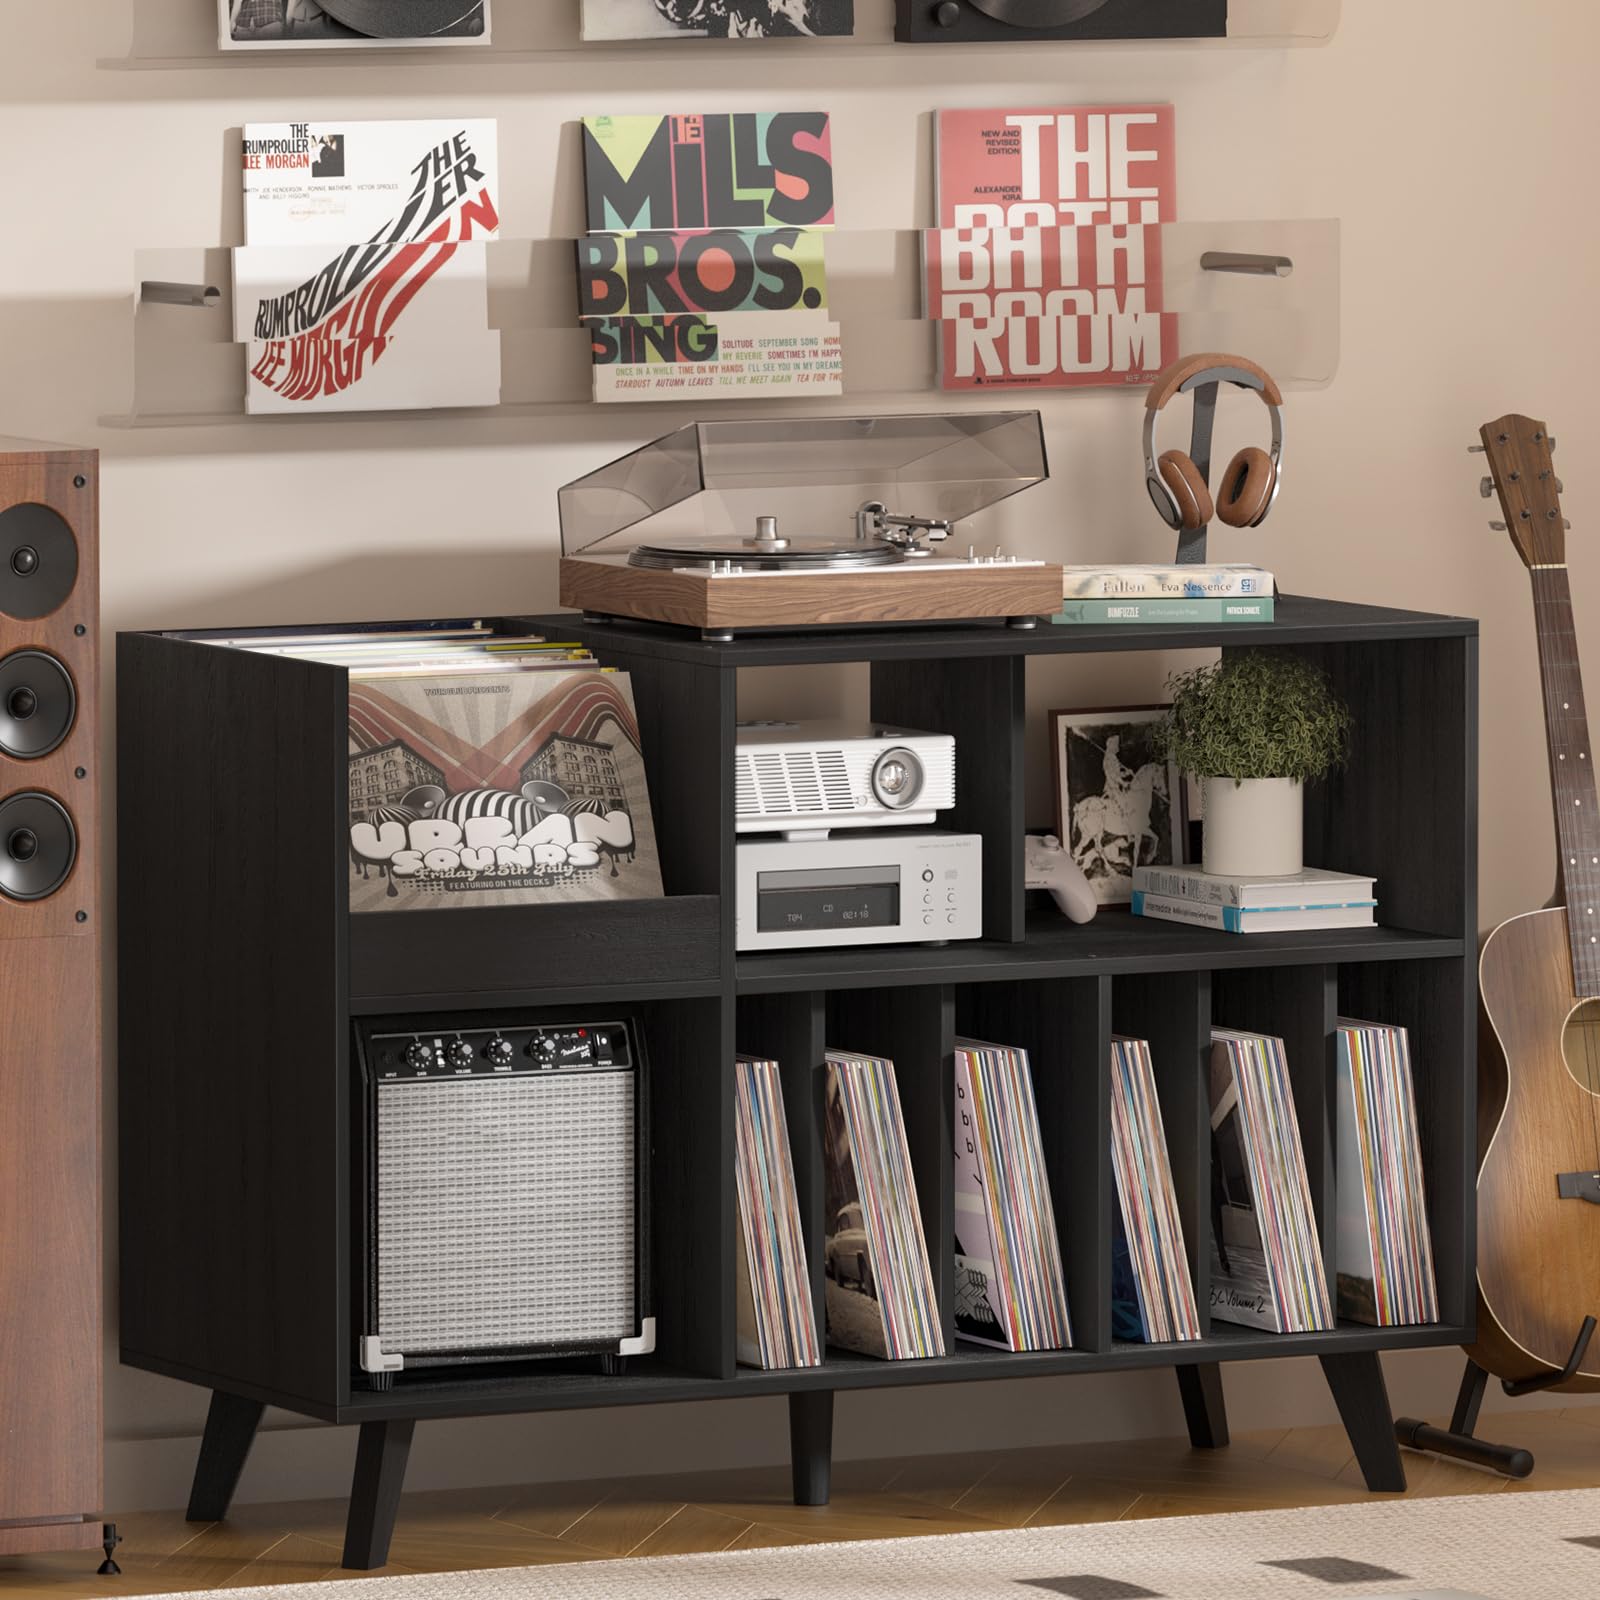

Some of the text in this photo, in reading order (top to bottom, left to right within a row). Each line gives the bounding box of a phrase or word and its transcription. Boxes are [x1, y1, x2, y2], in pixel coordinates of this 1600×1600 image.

[290, 123, 309, 138] THE
[243, 139, 310, 154] RUMPROLLER
[987, 147, 1020, 155] EDITION
[242, 154, 310, 169] LEE MORGAN
[1005, 113, 1158, 200] THE
[406, 130, 472, 201] THE
[940, 200, 1159, 291] BATH
[576, 231, 822, 316] BROS.
[585, 314, 718, 364] SING
[942, 287, 1161, 377] ROOM
[722, 339, 753, 348] SOLITUDE
[758, 338, 797, 347] SEPTEMBER
[800, 337, 819, 346] SONG
[723, 349, 842, 360] MY REVERIE SOMETIMES I'M HAPPY
[250, 340, 286, 389] LEE
[615, 367, 633, 376] ONCE
[636, 367, 643, 376] IN
[646, 367, 650, 375] A
[653, 366, 673, 375] WHILE
[678, 366, 694, 375] TIME
[697, 365, 706, 374] ON
[708, 365, 719, 373] MY
[721, 364, 744, 373] HANDS
[763, 363, 775, 372] SEE
[778, 363, 791, 371] YOU
[793, 362, 801, 370] IN
[803, 361, 813, 370] MY
[816, 361, 842, 370] DREAMS
[615, 379, 651, 389] STARDUST
[656, 378, 685, 387] AUTUMN
[688, 377, 714, 387] LEAVES
[719, 376, 733, 385] TILL
[736, 376, 746, 385] WE
[750, 375, 768, 384] MEET
[771, 374, 793, 384] AGAIN
[797, 374, 810, 383] TEA
[813, 373, 826, 382] FOR
[1161, 583, 1232, 592] Eva Nessence
[350, 811, 635, 860] URBAN
[391, 842, 601, 875] SOUNDS
[414, 867, 479, 881] Friday
[533, 862, 576, 877] July
[449, 878, 550, 890] FEATURING ON THE DECKS
[823, 904, 834, 912] CD
